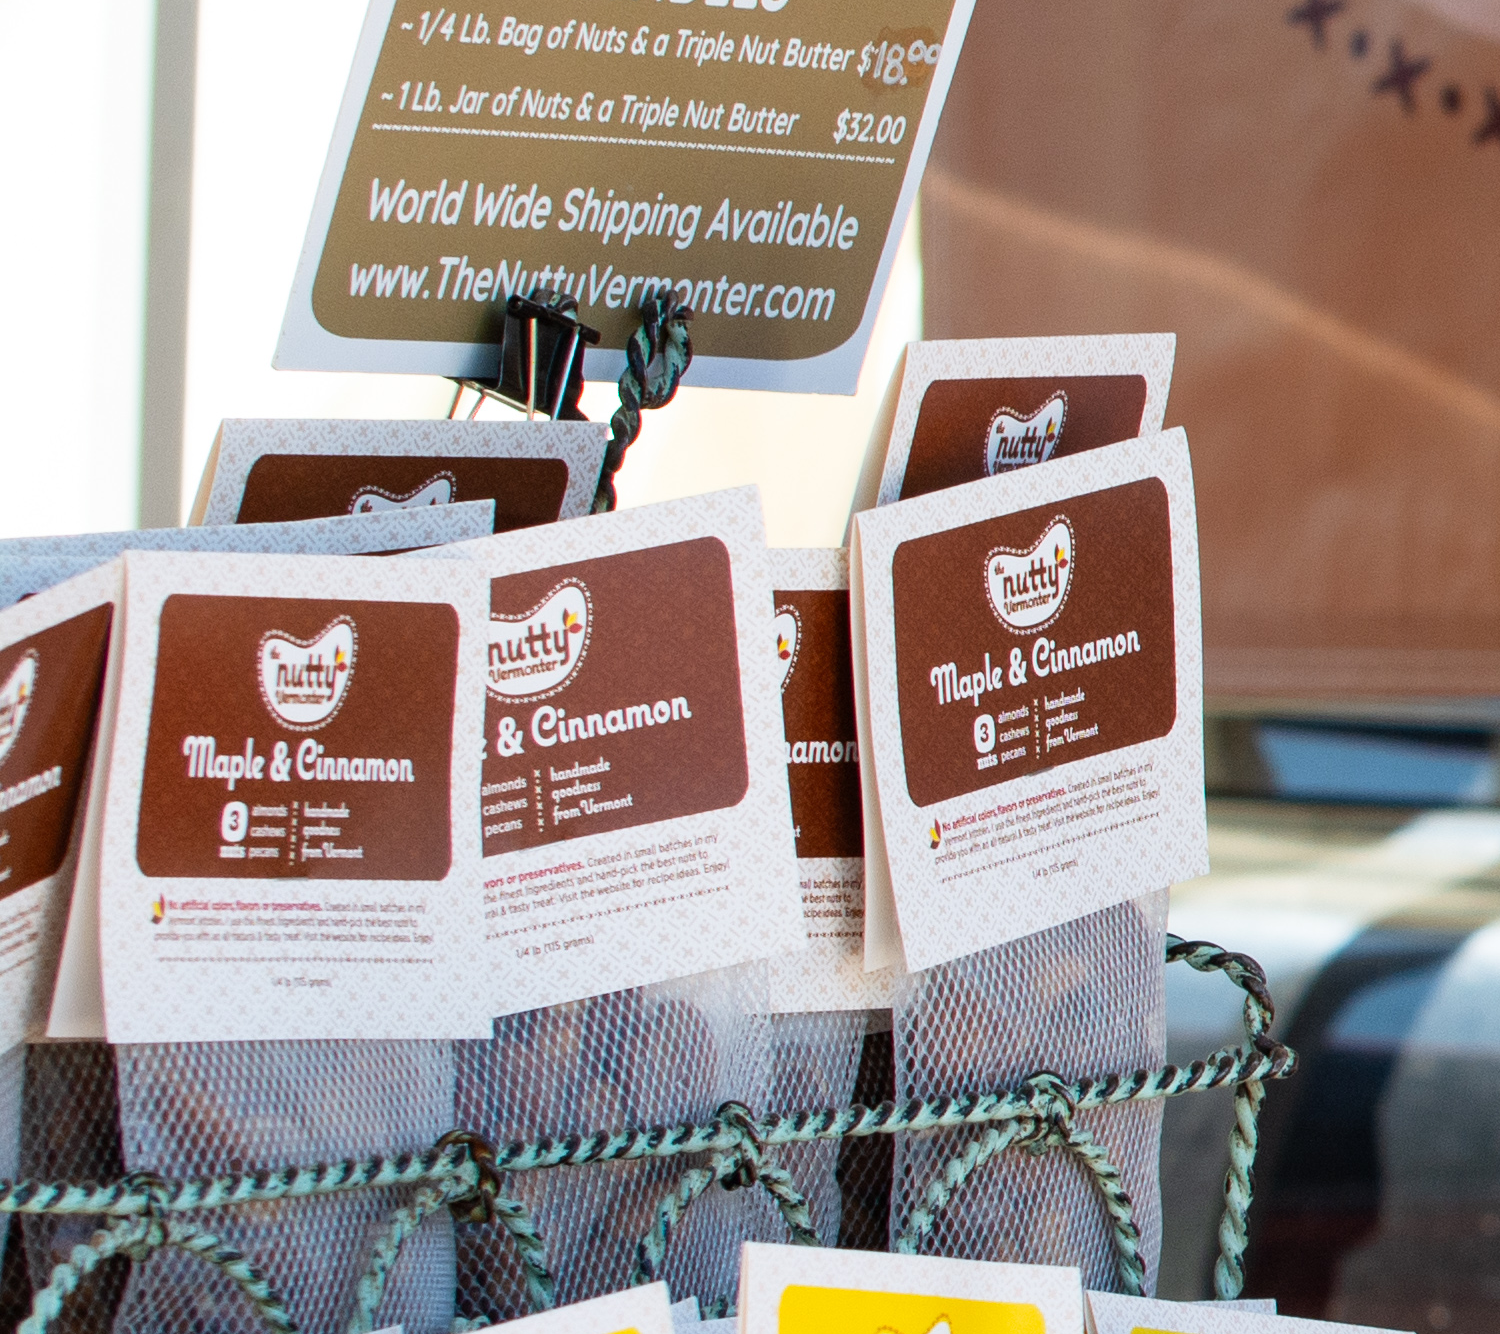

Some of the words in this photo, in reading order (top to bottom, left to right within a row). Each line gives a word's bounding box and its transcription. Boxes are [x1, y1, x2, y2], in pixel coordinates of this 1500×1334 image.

[400, 81, 410, 109] 1
[412, 81, 442, 112] Lb.
[449, 85, 489, 114] Jar
[492, 86, 521, 116] of
[520, 89, 572, 120] Nuts
[576, 92, 594, 121] &
[598, 100, 614, 122] a
[621, 95, 679, 132] Triple
[683, 100, 725, 129] Nut
[728, 103, 800, 135] Butter
[833, 108, 906, 144] $32.00
[370, 178, 468, 225] World
[474, 183, 551, 229] Wide
[558, 187, 702, 249] Shipping
[705, 198, 858, 249] Available
[1003, 558, 1059, 600] nutty
[488, 623, 571, 667] nutty
[930, 653, 1002, 706] Maple
[1009, 648, 1027, 686] &
[1032, 631, 1140, 677] Cinnamon
[497, 717, 524, 757] &
[532, 697, 691, 747] Cinnamon
[183, 736, 265, 790] Maple
[270, 741, 291, 781] &
[297, 738, 414, 782] Cinnamon
